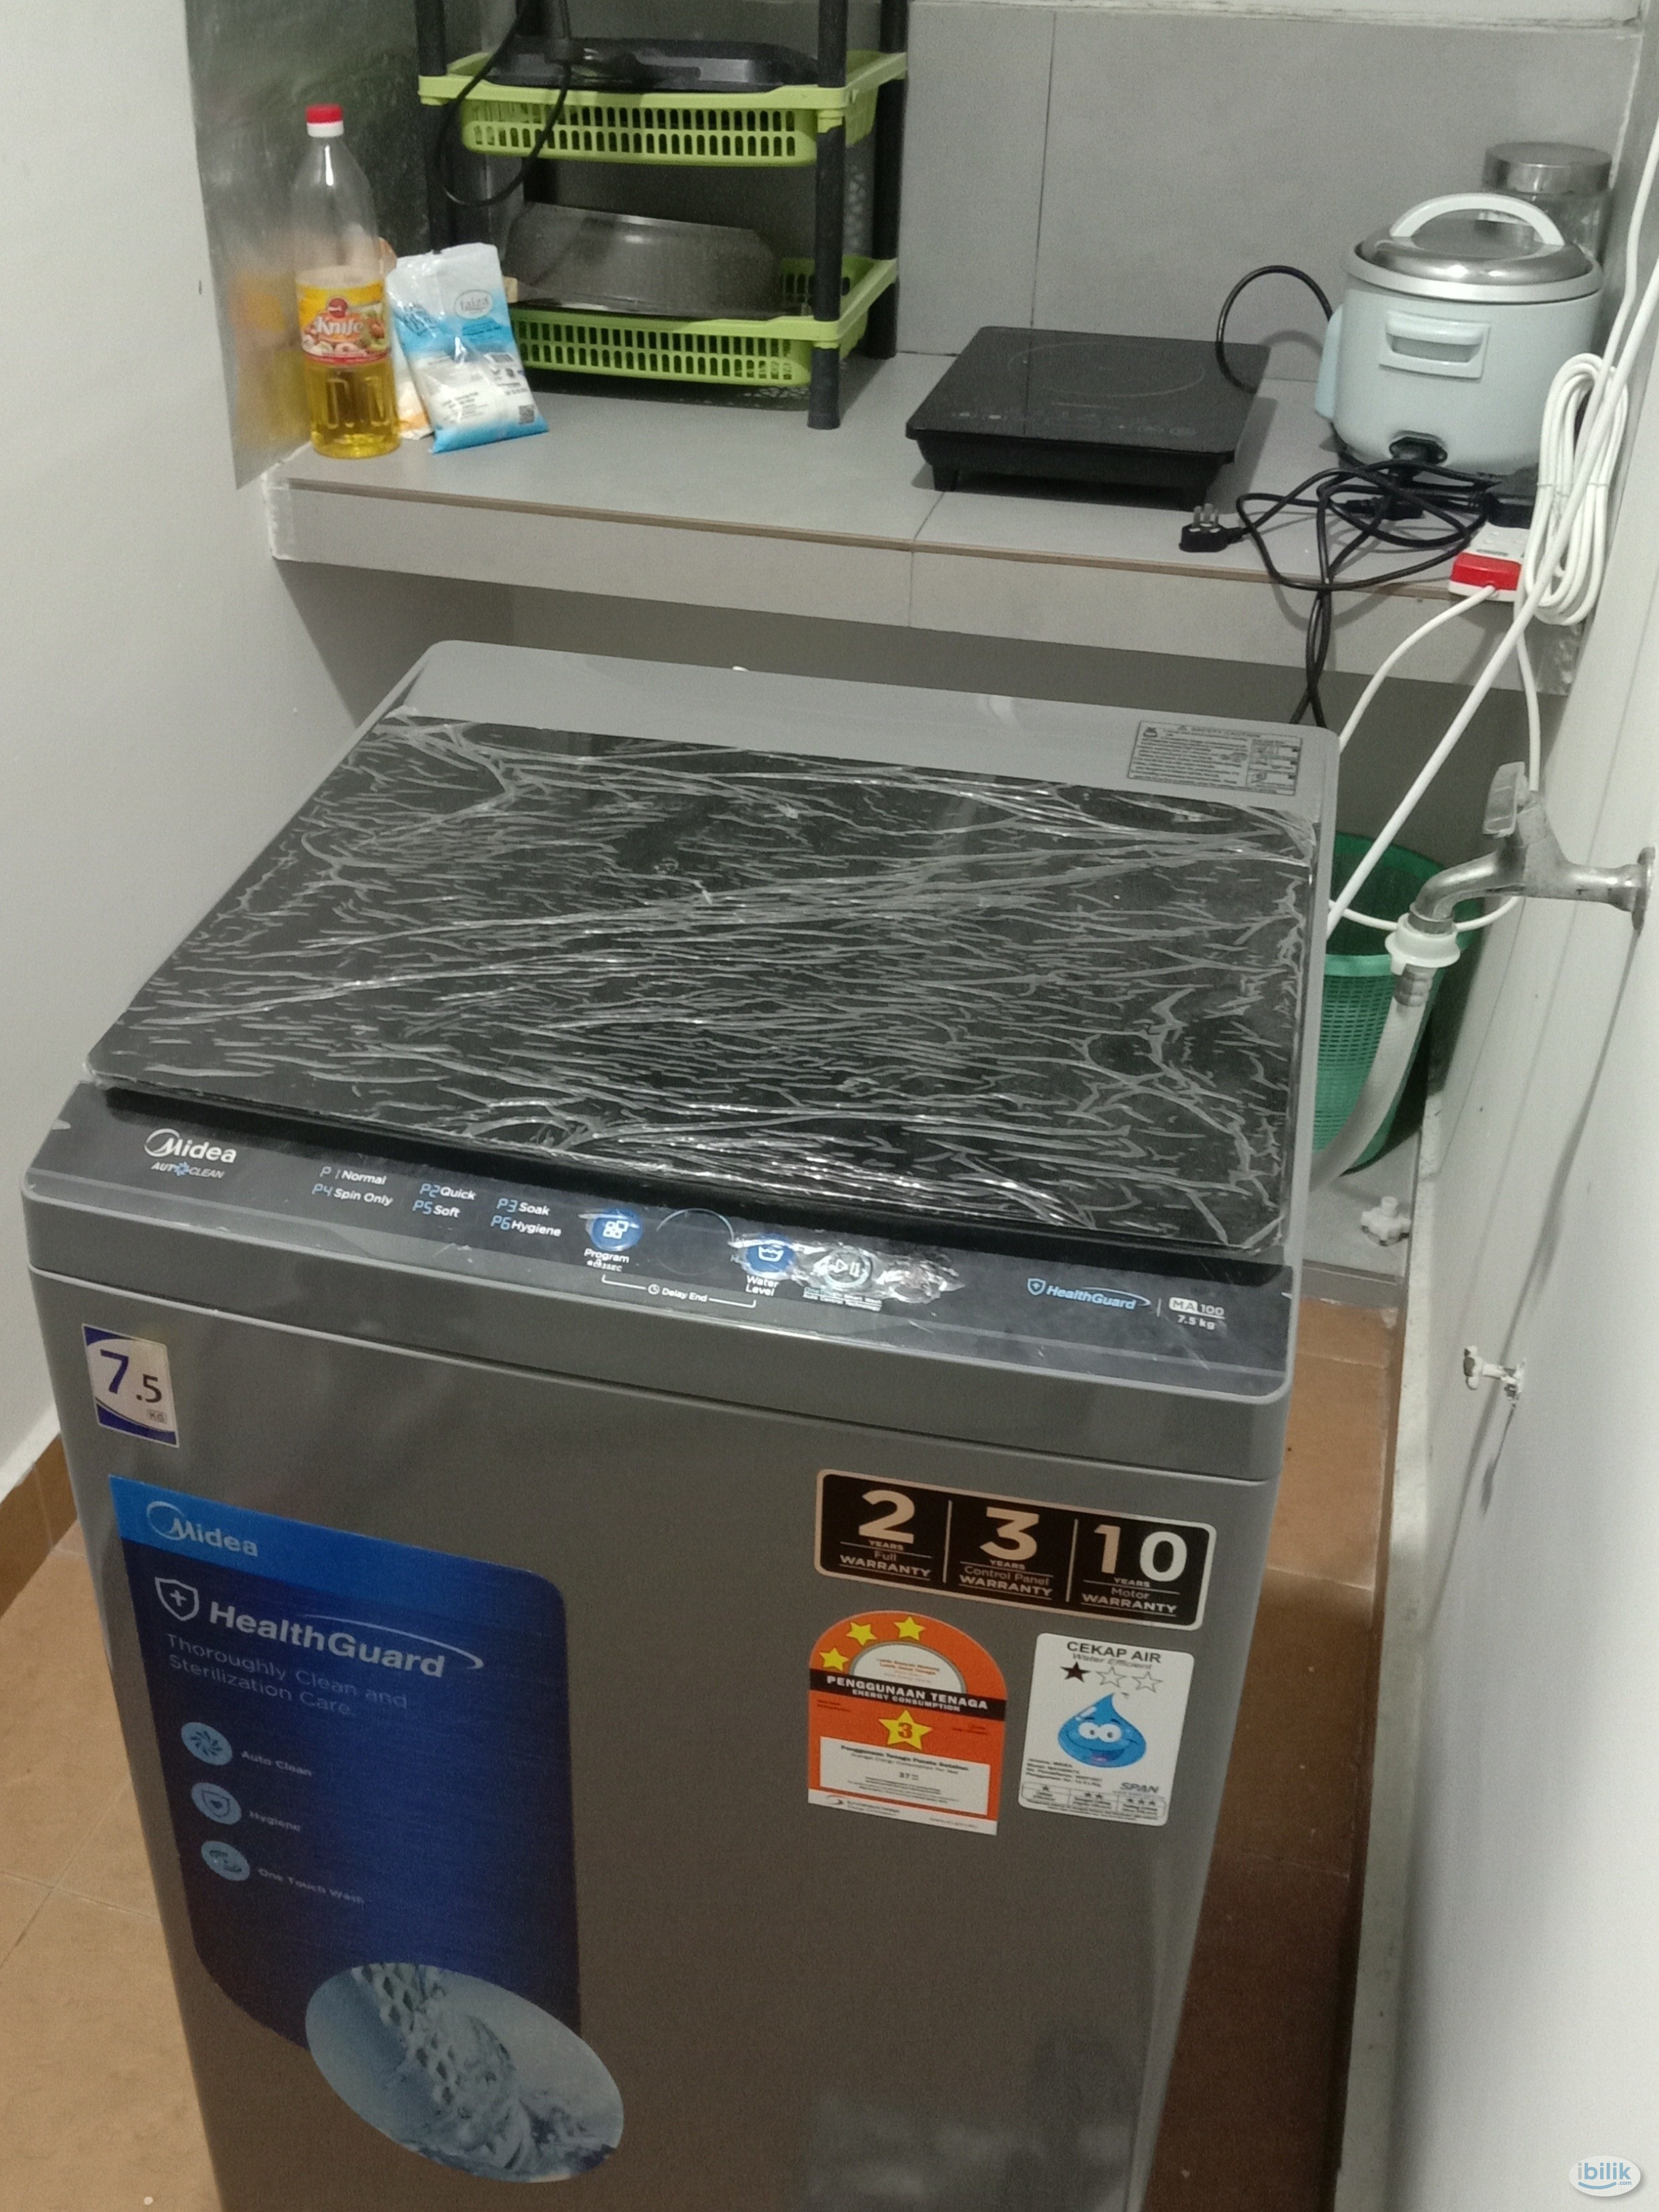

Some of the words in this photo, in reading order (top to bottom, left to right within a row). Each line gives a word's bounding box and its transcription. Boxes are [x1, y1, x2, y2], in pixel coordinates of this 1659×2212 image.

[314, 316, 363, 335] Knife
[144, 1128, 237, 1163] Midea
[341, 1170, 387, 1185] Normal
[333, 1188, 361, 1200] Spin
[363, 1192, 394, 1206] Only
[420, 1183, 440, 1198] P2
[440, 1186, 476, 1201] Quick
[433, 1205, 460, 1217] Soft
[496, 1198, 518, 1213] P3
[518, 1202, 550, 1216] Soak
[490, 1215, 511, 1230] P6
[511, 1219, 562, 1237] Hygiene
[584, 1248, 629, 1263] Program
[745, 1285, 775, 1297] Level
[746, 1275, 779, 1288] Water
[662, 1288, 688, 1300] Delay
[689, 1292, 707, 1303] End
[1046, 1285, 1137, 1310] HealthGuard
[1172, 1298, 1198, 1311] MA
[1201, 1304, 1225, 1316] 100
[1177, 1314, 1197, 1326] 7.5
[1198, 1317, 1216, 1331] kg
[100, 1349, 161, 1403] 7.5
[859, 1489, 915, 1544] 2
[146, 1501, 258, 1557] Midea
[979, 1506, 1039, 1561] 3
[868, 1540, 904, 1551] YEARS
[1094, 1524, 1187, 1582] 10
[840, 1554, 932, 1577] WARRANTY
[874, 1550, 896, 1562] Full
[989, 1559, 1025, 1570] YEARS
[959, 1574, 1053, 1596] WARRANTY
[964, 1566, 1011, 1581] Control
[1014, 1574, 1049, 1586] Panel
[1114, 1576, 1150, 1588] YEARS
[1082, 1593, 1177, 1614] WARRANTY
[1111, 1587, 1150, 1600] Motor
[208, 1601, 445, 1678] HealthGuard
[1067, 1641, 1128, 1657] CEKAP
[1131, 1651, 1161, 1663] AIR
[166, 1634, 287, 1681] Thoroughly
[295, 1669, 357, 1697] Clean
[366, 1688, 408, 1710] and
[168, 1654, 293, 1702] Sterilization
[300, 1691, 352, 1716] Care
[826, 1675, 926, 1701] PENGGUNAAN
[930, 1692, 988, 1710] TENAGA
[852, 1689, 889, 1701] ENERGY
[892, 1695, 961, 1712] CONSUMPTION
[898, 1722, 913, 1738] 3
[242, 1750, 271, 1766] Auto
[275, 1761, 312, 1777] Clean
[1120, 1782, 1159, 1793] SPAN
[249, 1810, 301, 1832] Hygiene
